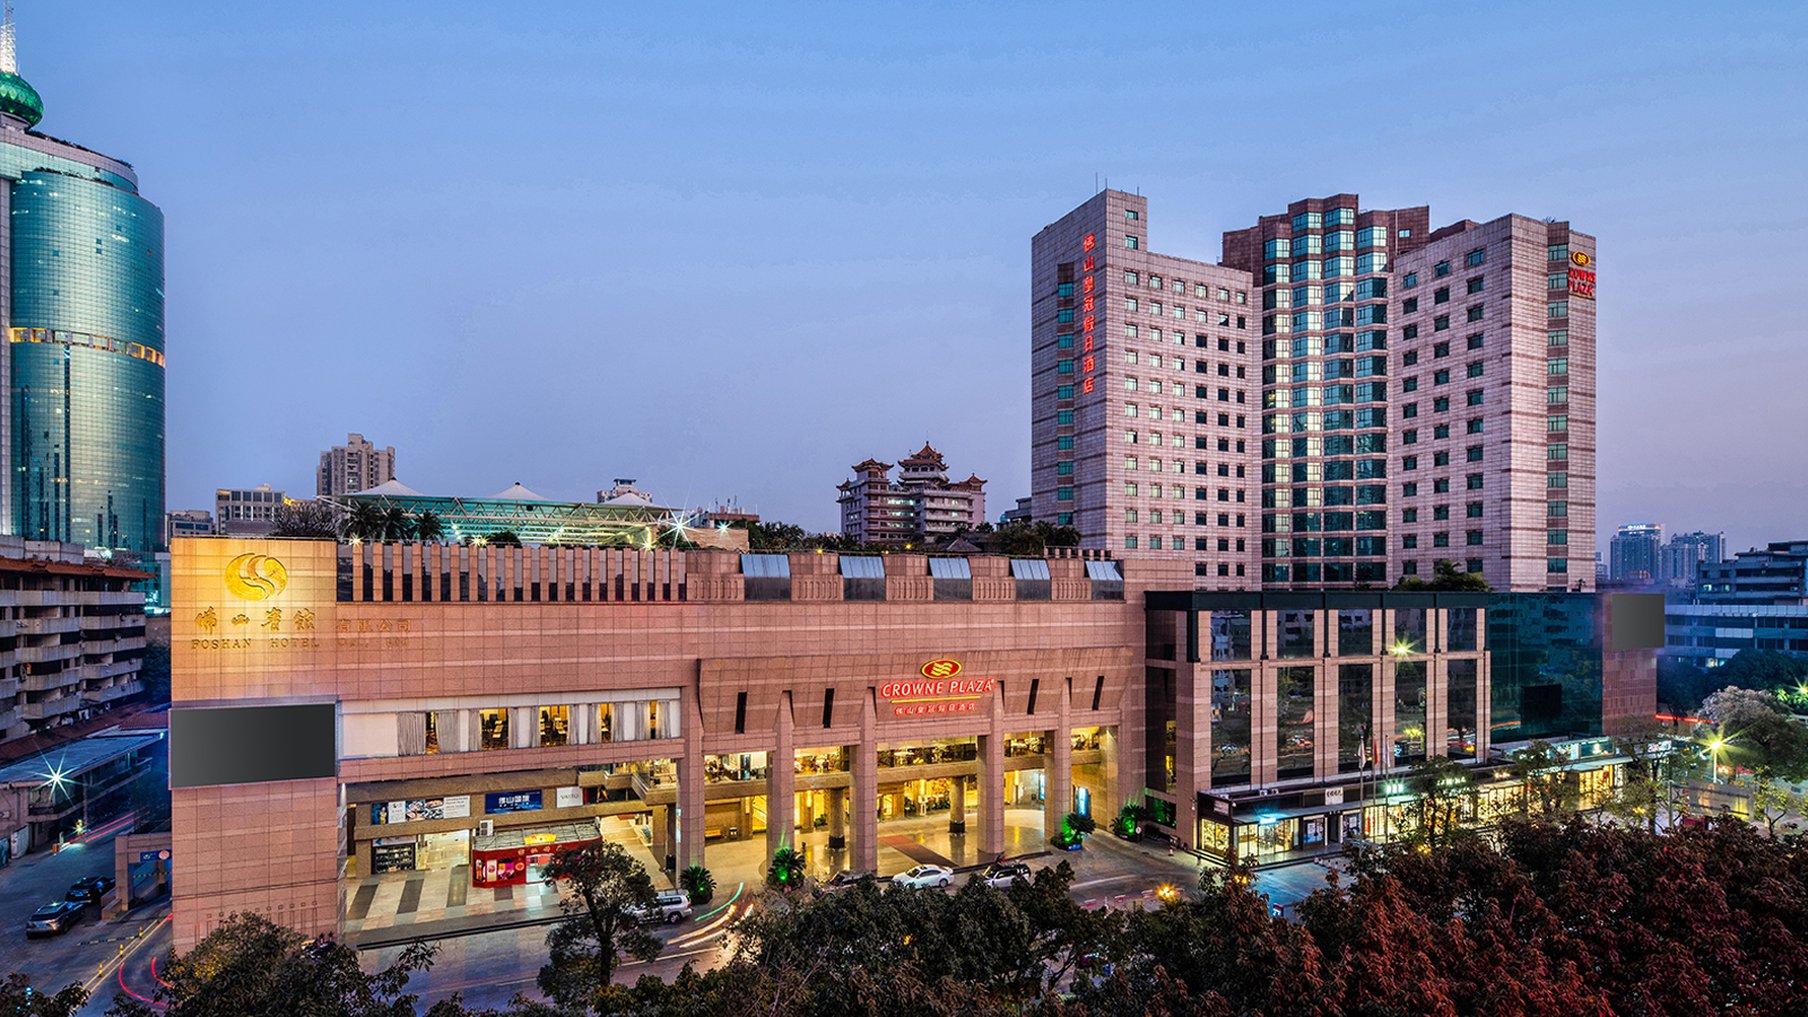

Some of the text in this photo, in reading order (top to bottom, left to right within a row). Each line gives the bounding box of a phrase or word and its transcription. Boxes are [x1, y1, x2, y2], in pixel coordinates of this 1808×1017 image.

[1083, 233, 1095, 394] 佛山皇冠假日酒店
[191, 637, 320, 650] FOSHAN HOTEL
[882, 679, 993, 698] CROWNE PLAZA
